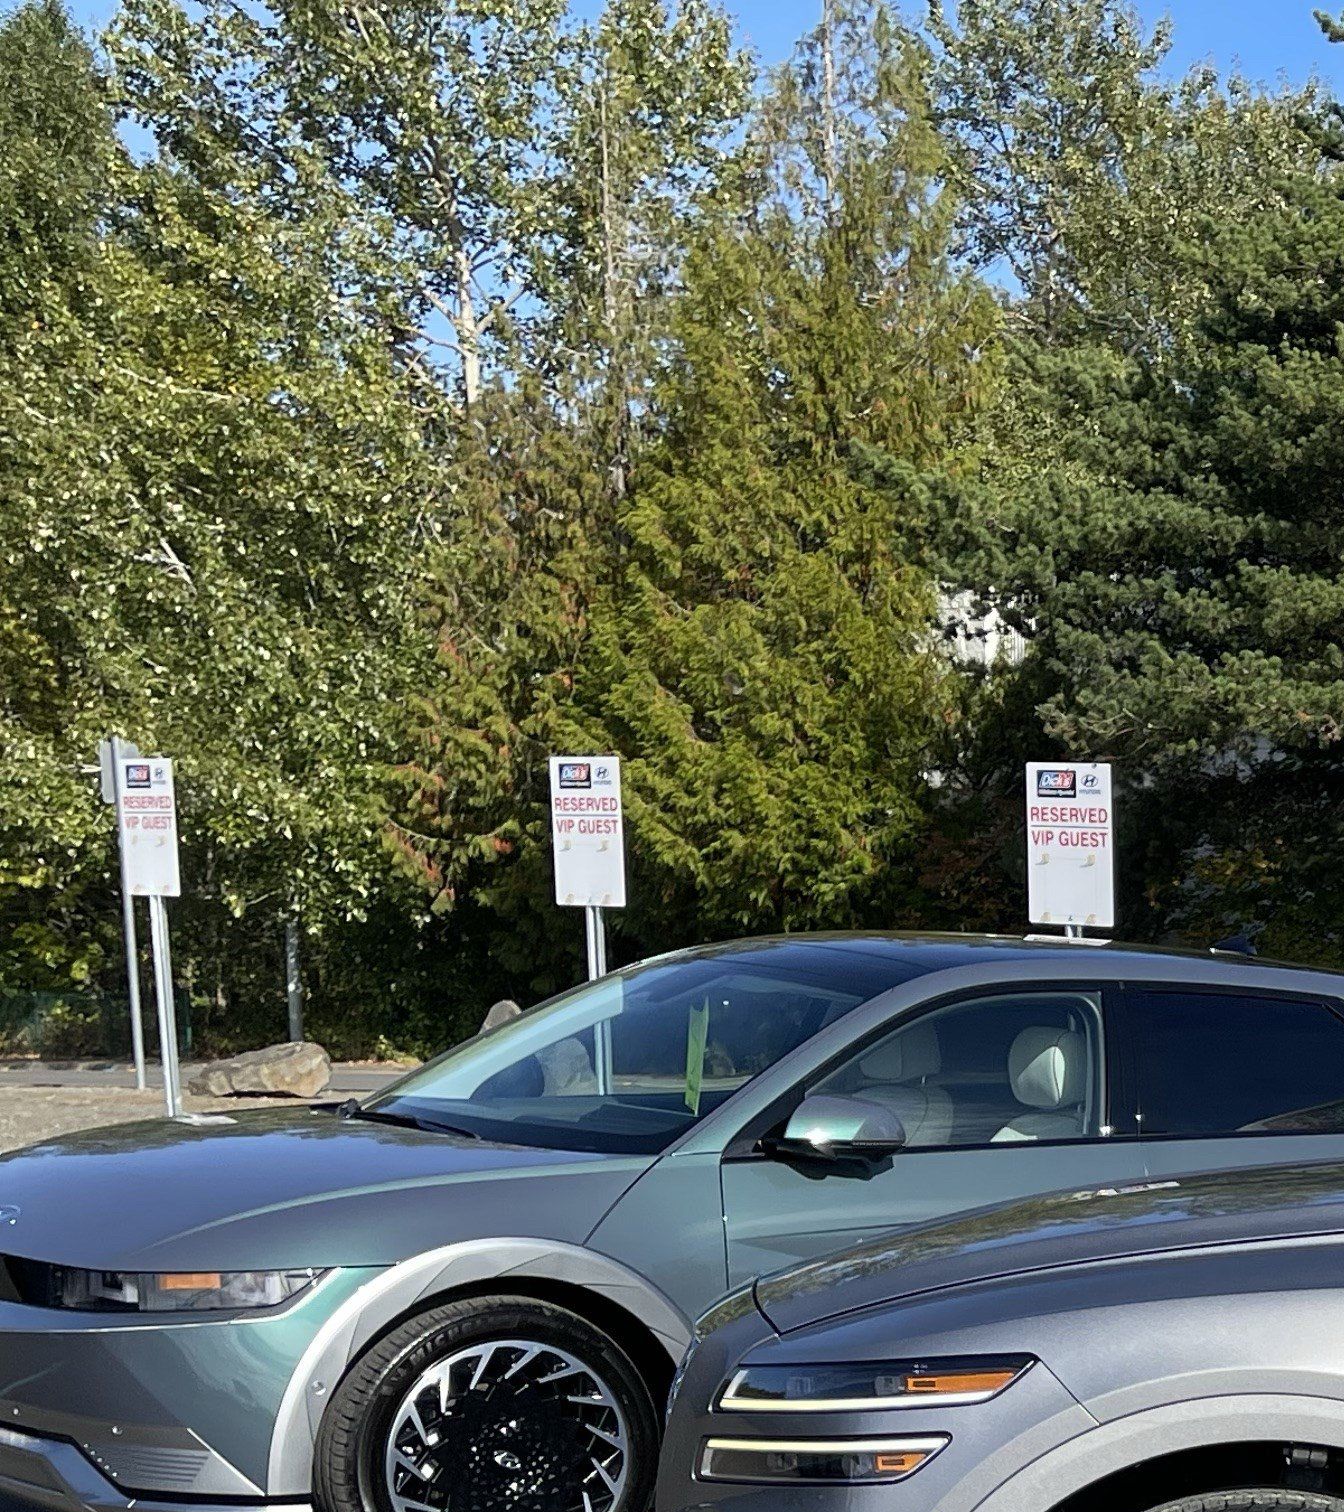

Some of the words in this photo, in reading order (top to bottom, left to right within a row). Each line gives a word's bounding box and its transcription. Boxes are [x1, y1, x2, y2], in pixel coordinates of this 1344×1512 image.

[554, 797, 618, 811] RESERVED
[1030, 806, 1108, 824] RESERVED
[556, 819, 575, 834] VIP
[578, 819, 618, 834] GUEST
[1031, 830, 1054, 846] VIP
[1058, 831, 1108, 848] GUEST
